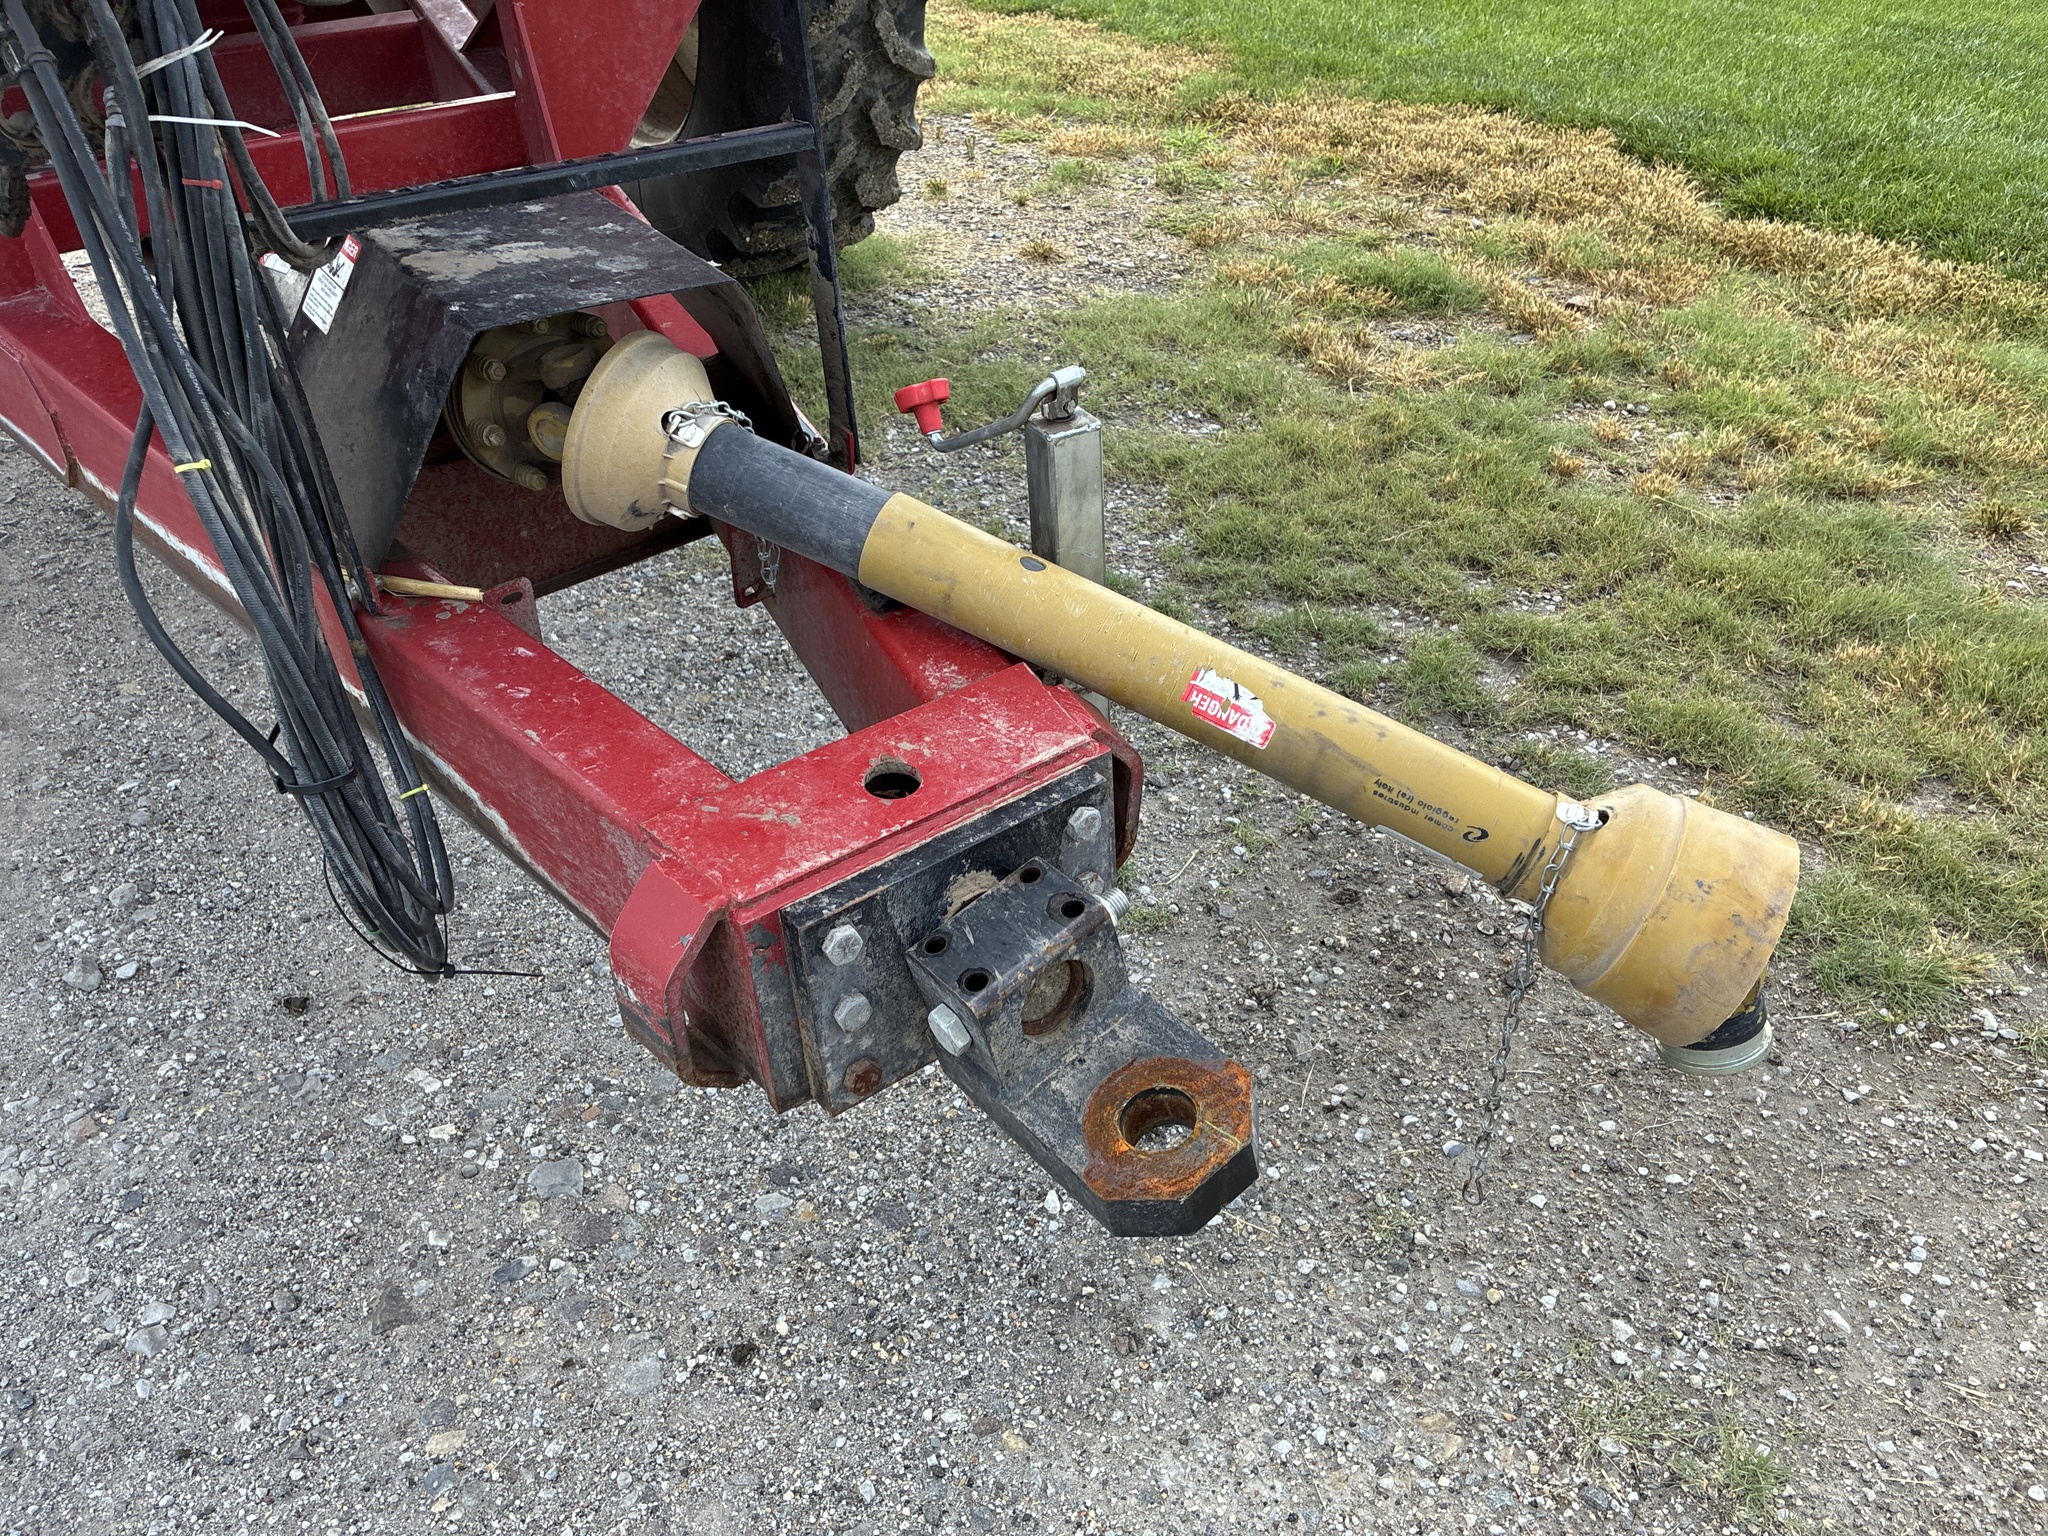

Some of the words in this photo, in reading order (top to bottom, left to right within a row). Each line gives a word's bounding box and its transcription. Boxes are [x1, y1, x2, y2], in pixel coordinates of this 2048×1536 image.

[171, 332, 187, 356] FLAME
[183, 358, 204, 395] RESISTANT
[1374, 778, 1395, 794] italy
[1396, 789, 1415, 804] (re)
[1372, 789, 1420, 816] industries
[1417, 800, 1460, 824] reggiolo
[1423, 814, 1454, 832] comer
